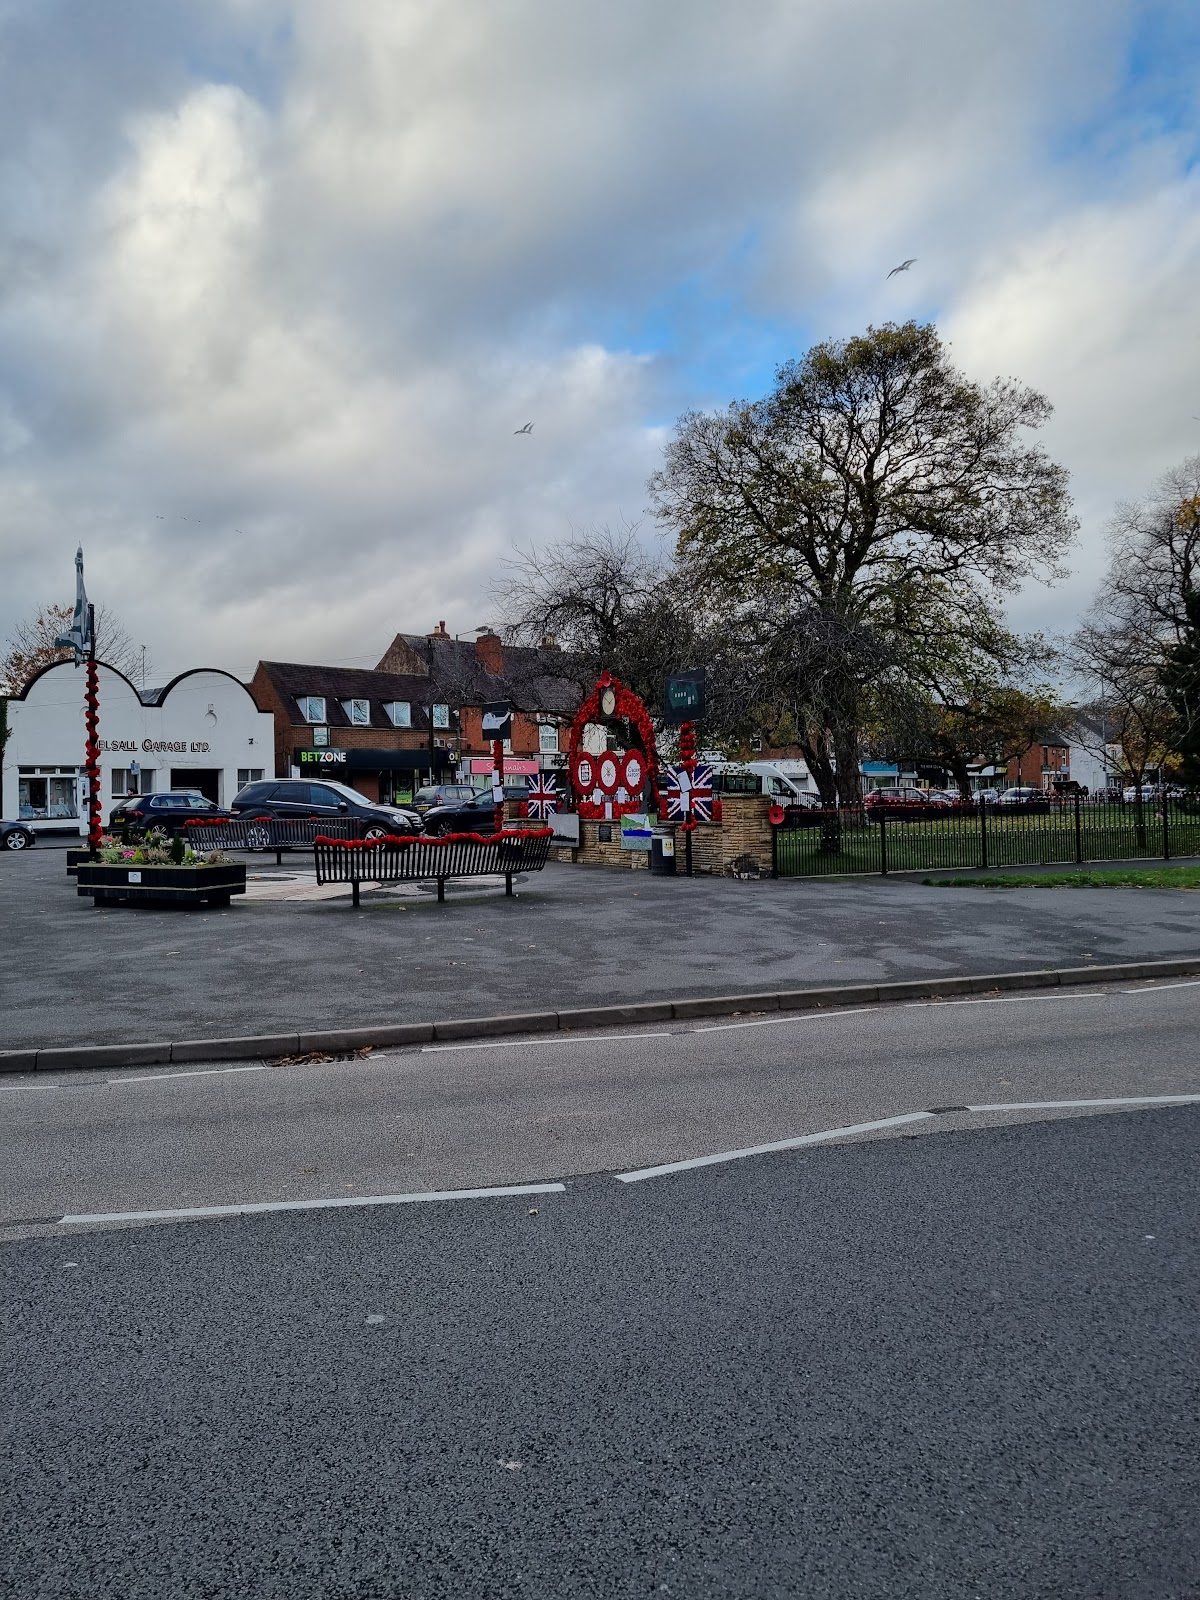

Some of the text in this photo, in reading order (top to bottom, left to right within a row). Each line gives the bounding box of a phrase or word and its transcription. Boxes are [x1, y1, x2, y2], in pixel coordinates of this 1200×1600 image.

[97, 740, 138, 752] ELSALL
[142, 738, 187, 752] GARAGE
[301, 751, 347, 763] BETZONE
